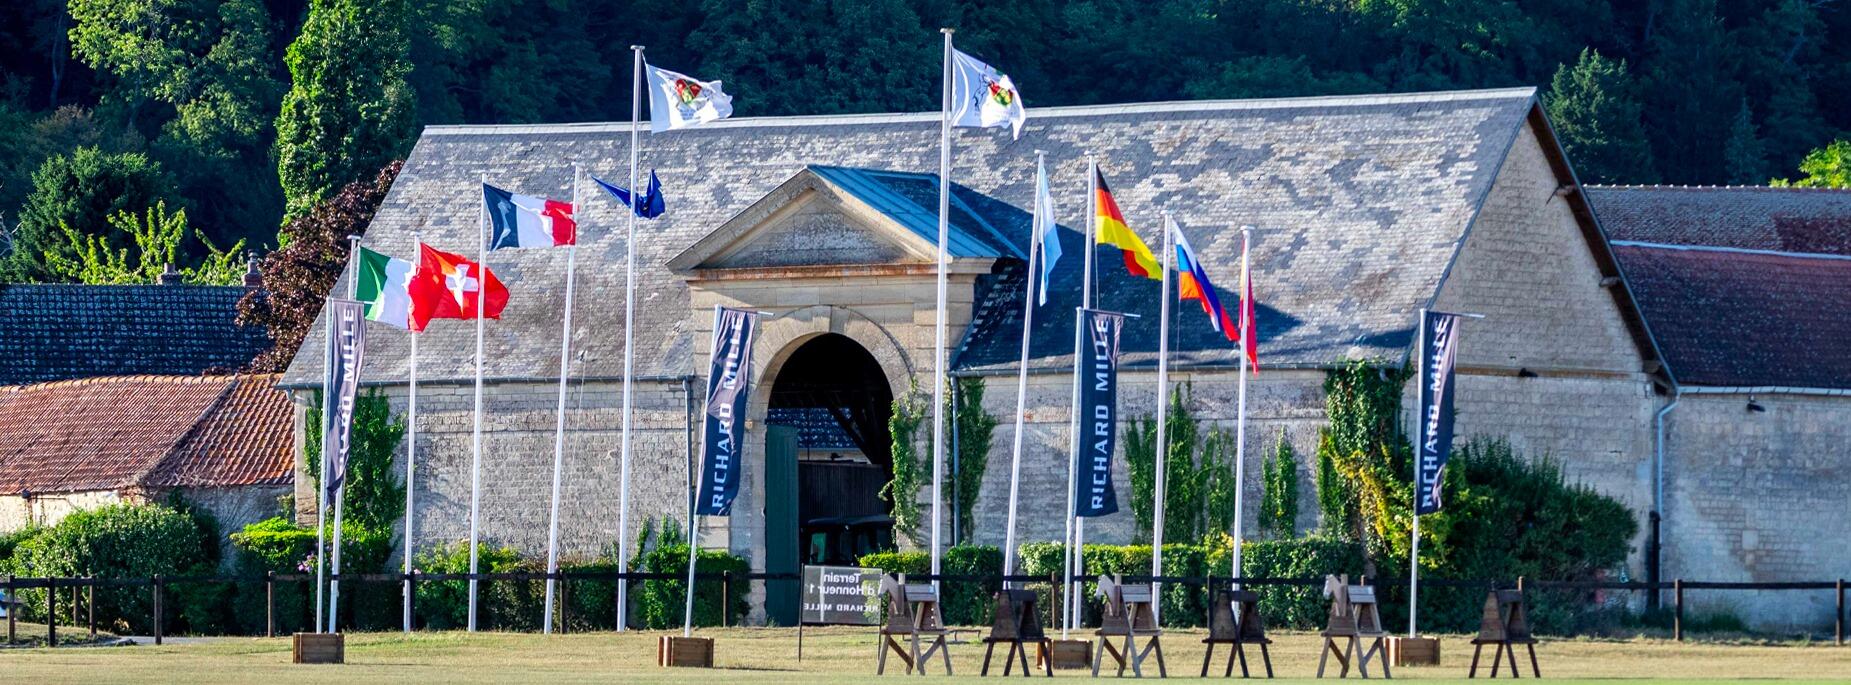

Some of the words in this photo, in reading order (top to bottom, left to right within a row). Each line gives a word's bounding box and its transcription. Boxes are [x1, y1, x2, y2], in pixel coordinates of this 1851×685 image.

[343, 307, 355, 382] MILLE
[1096, 319, 1110, 392] MILLE
[1430, 315, 1449, 392] MILLE
[711, 402, 733, 508] RICHARD
[723, 317, 743, 390] MILLE
[1091, 404, 1110, 510] RICHARD
[1421, 404, 1440, 508] RICHARD
